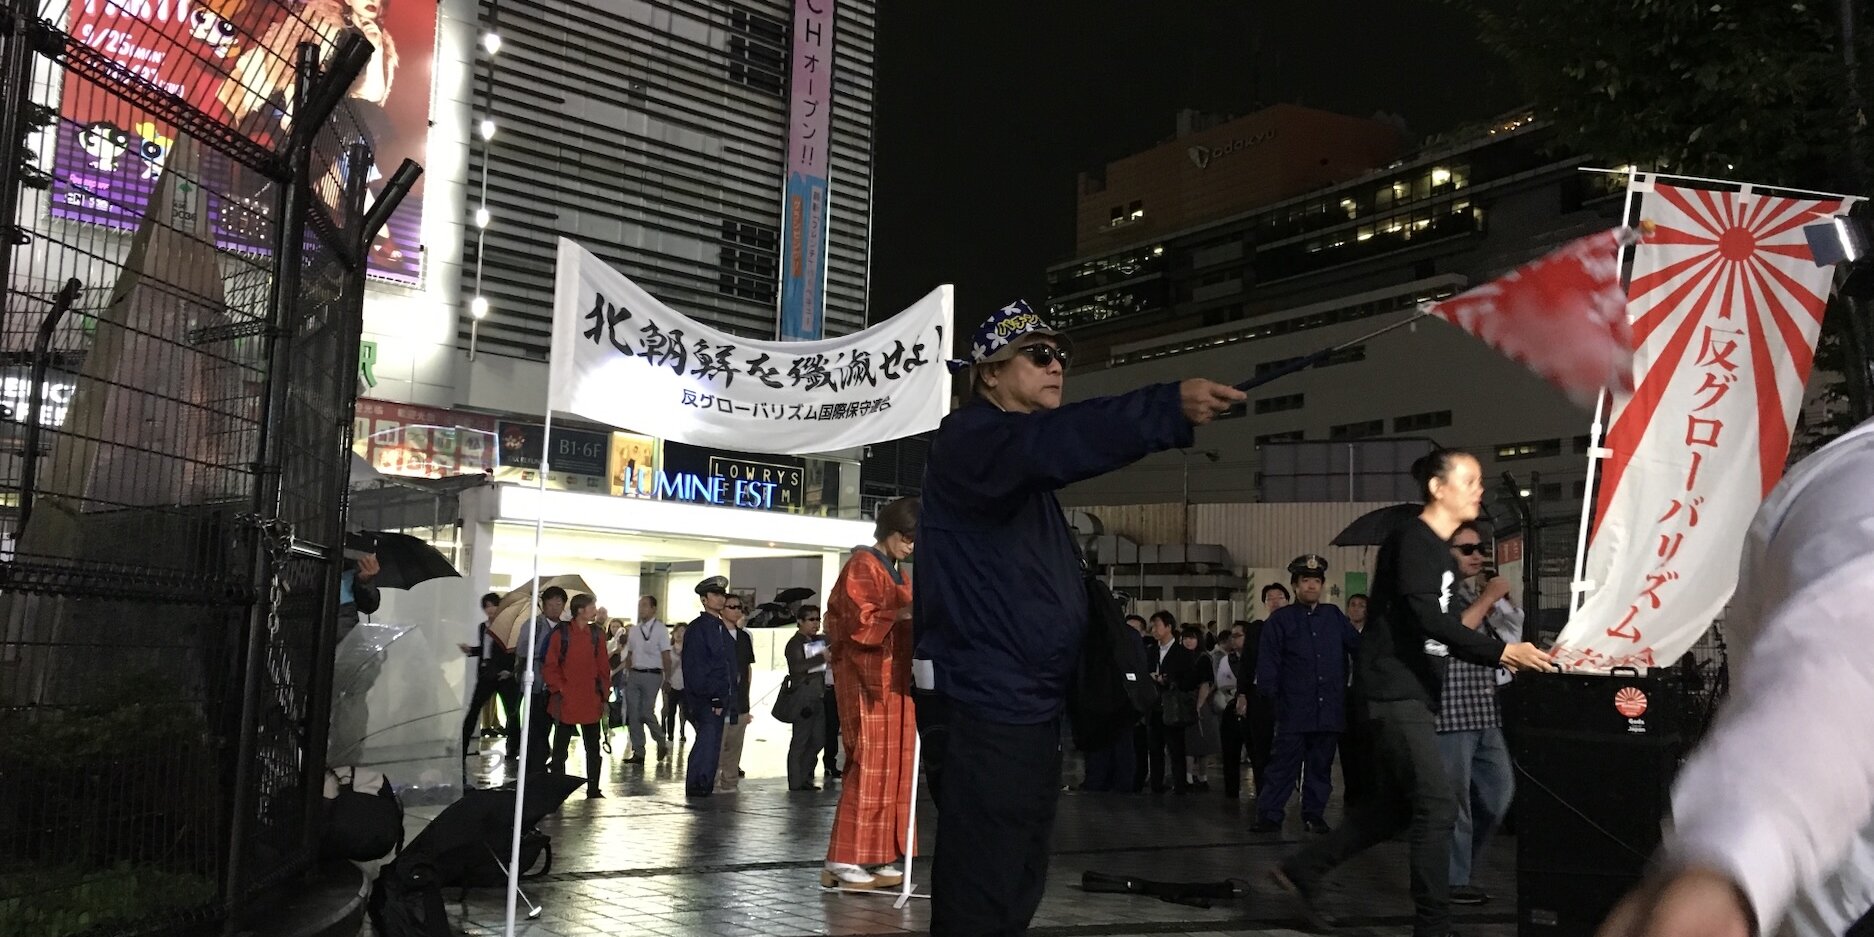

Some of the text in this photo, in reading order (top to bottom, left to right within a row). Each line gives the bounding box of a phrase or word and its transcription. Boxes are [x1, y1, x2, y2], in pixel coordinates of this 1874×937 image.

[681, 389, 891, 421] 反グローバリズム国際保守連合
[624, 466, 777, 509] LUMINE EST
[715, 462, 799, 486] LOWRYS
